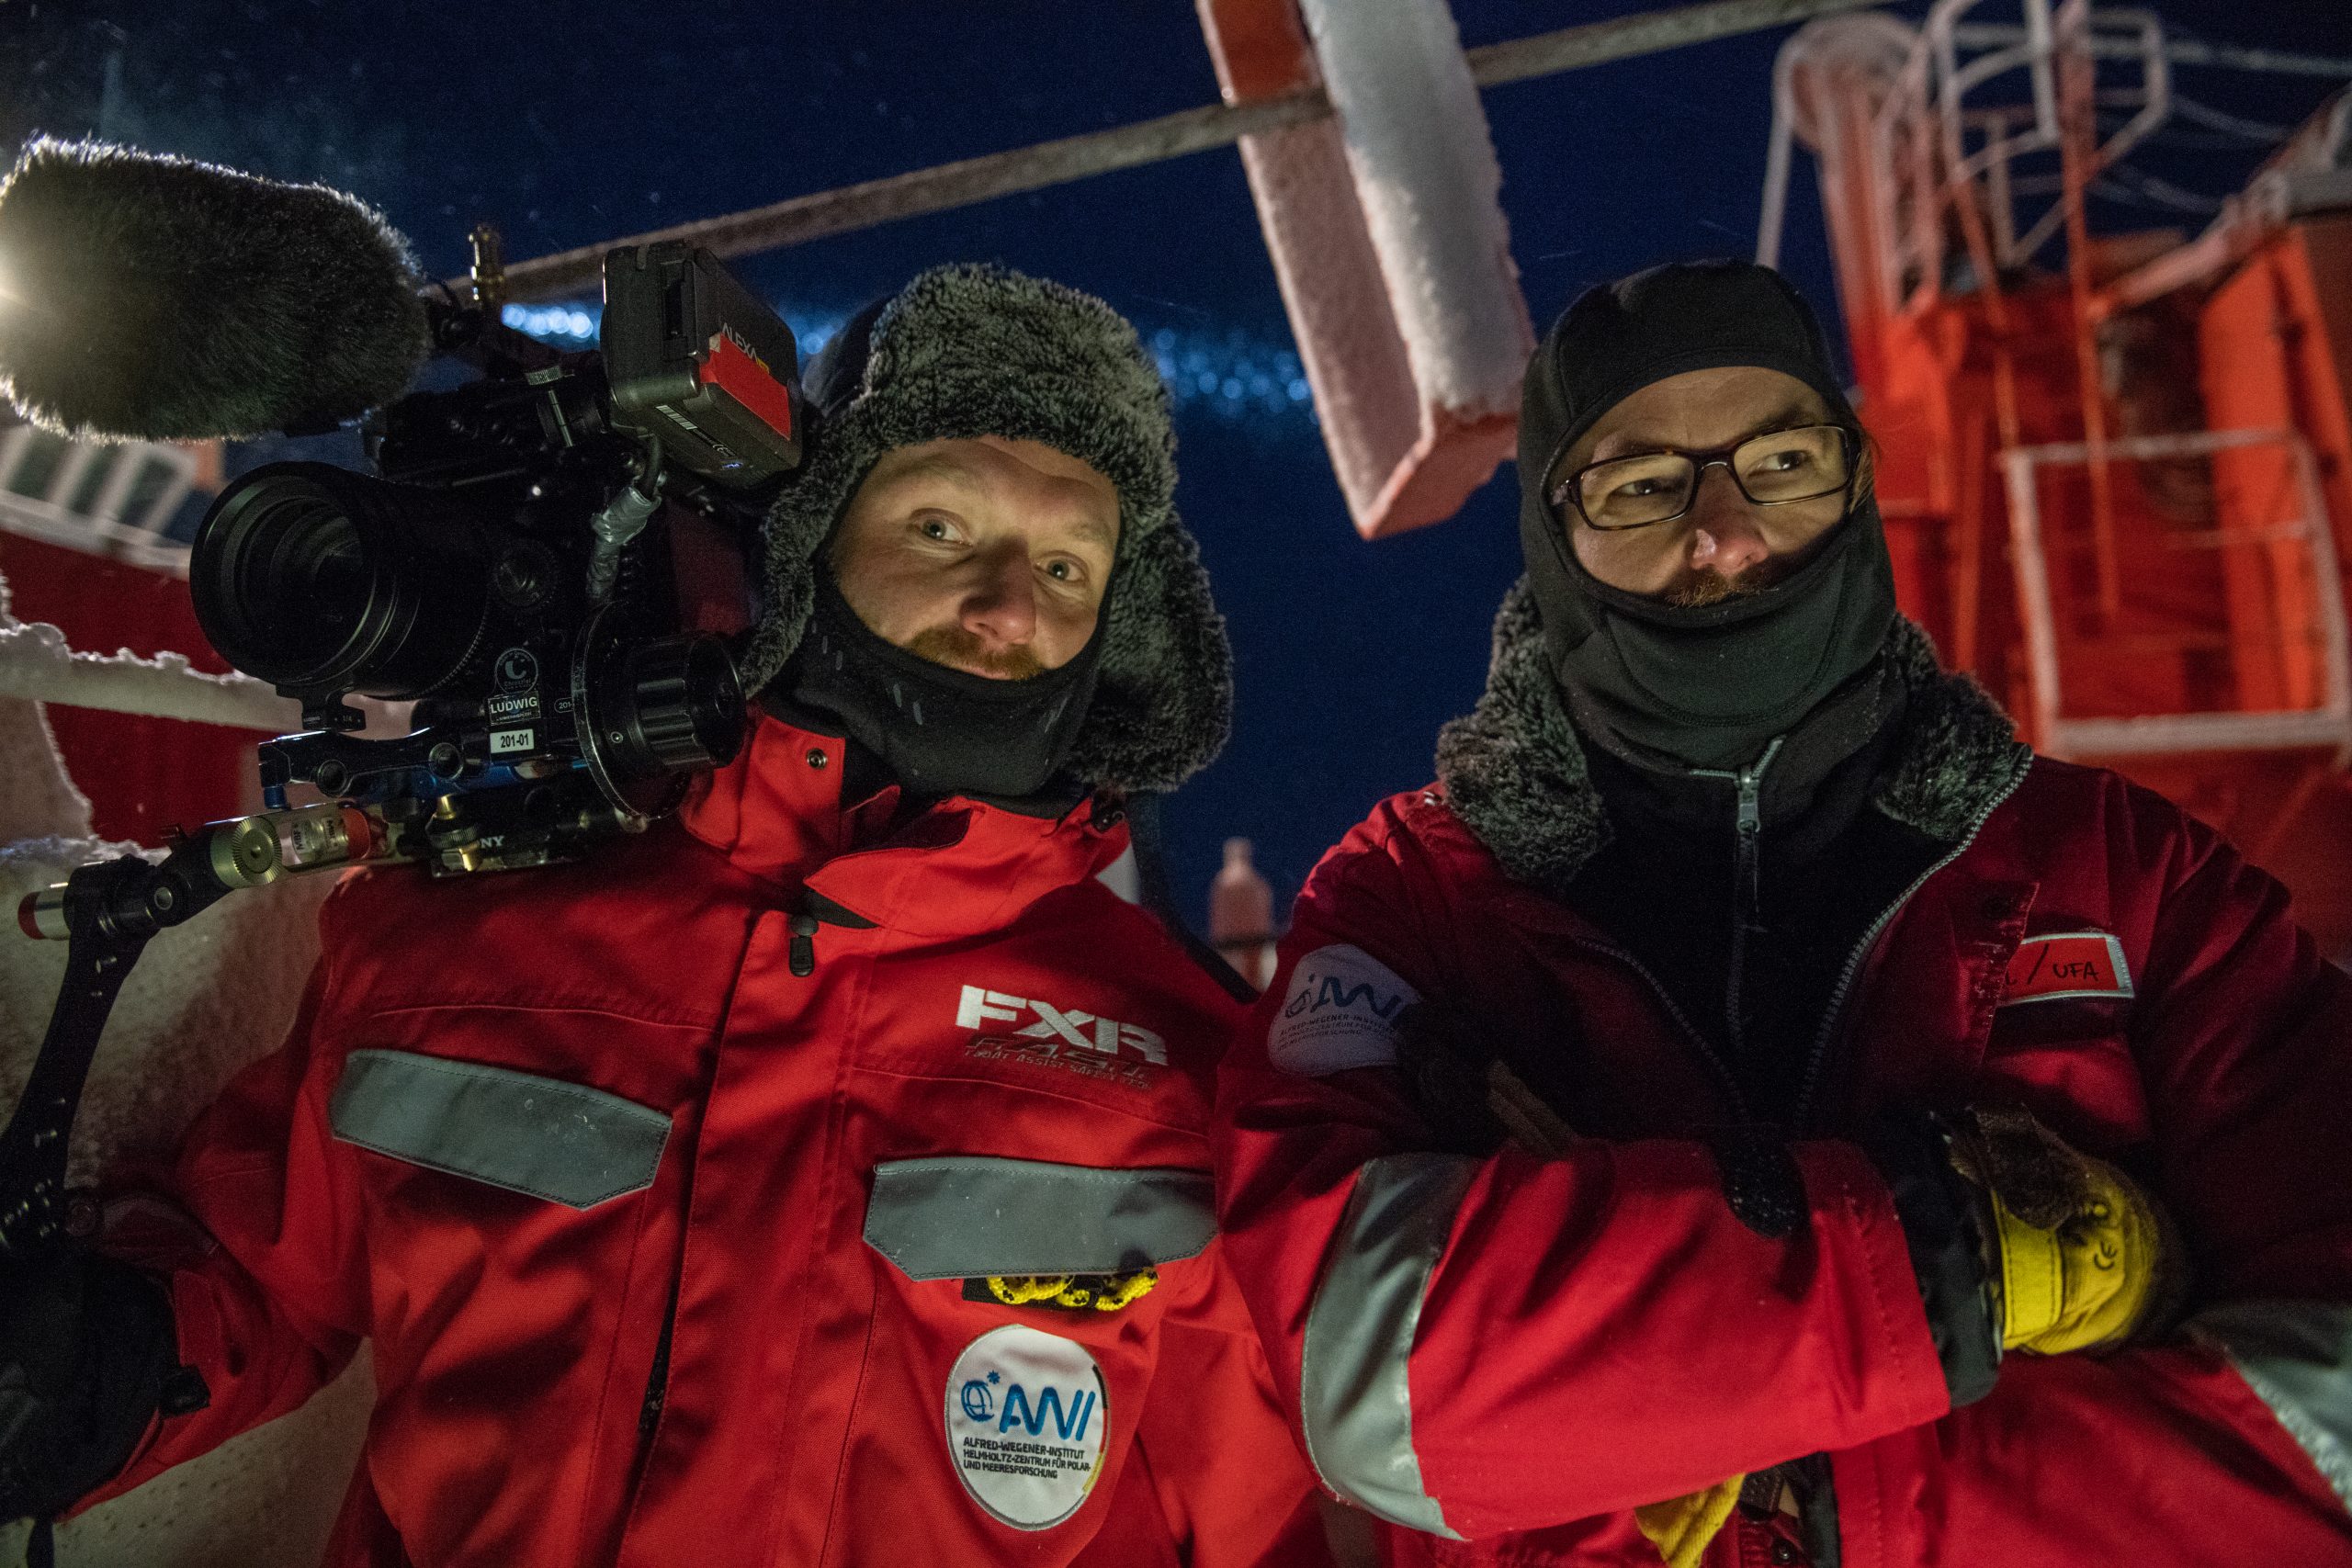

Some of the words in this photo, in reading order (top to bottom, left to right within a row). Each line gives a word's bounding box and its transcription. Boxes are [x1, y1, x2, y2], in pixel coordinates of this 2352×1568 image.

[490, 696, 538, 714] LUDWIG
[501, 733, 529, 749] 201-01
[480, 835, 505, 850] NY
[2052, 961, 2099, 982] UFA
[956, 984, 1168, 1066] FXR
[1016, 1054, 1064, 1069] ASSIST
[2094, 1241, 2118, 1271] CE
[1000, 1383, 1096, 1441] AWI
[963, 1436, 1085, 1460] ALFRED-WEGENER-INSTITUT
[963, 1449, 1051, 1467] HELMHOLTZ-ZENTRUM
[1051, 1457, 1066, 1469] FÜR
[1067, 1461, 1091, 1472] POLAR-
[963, 1460, 981, 1471] UND
[982, 1461, 1058, 1479] MEERESFORSCHUNG
